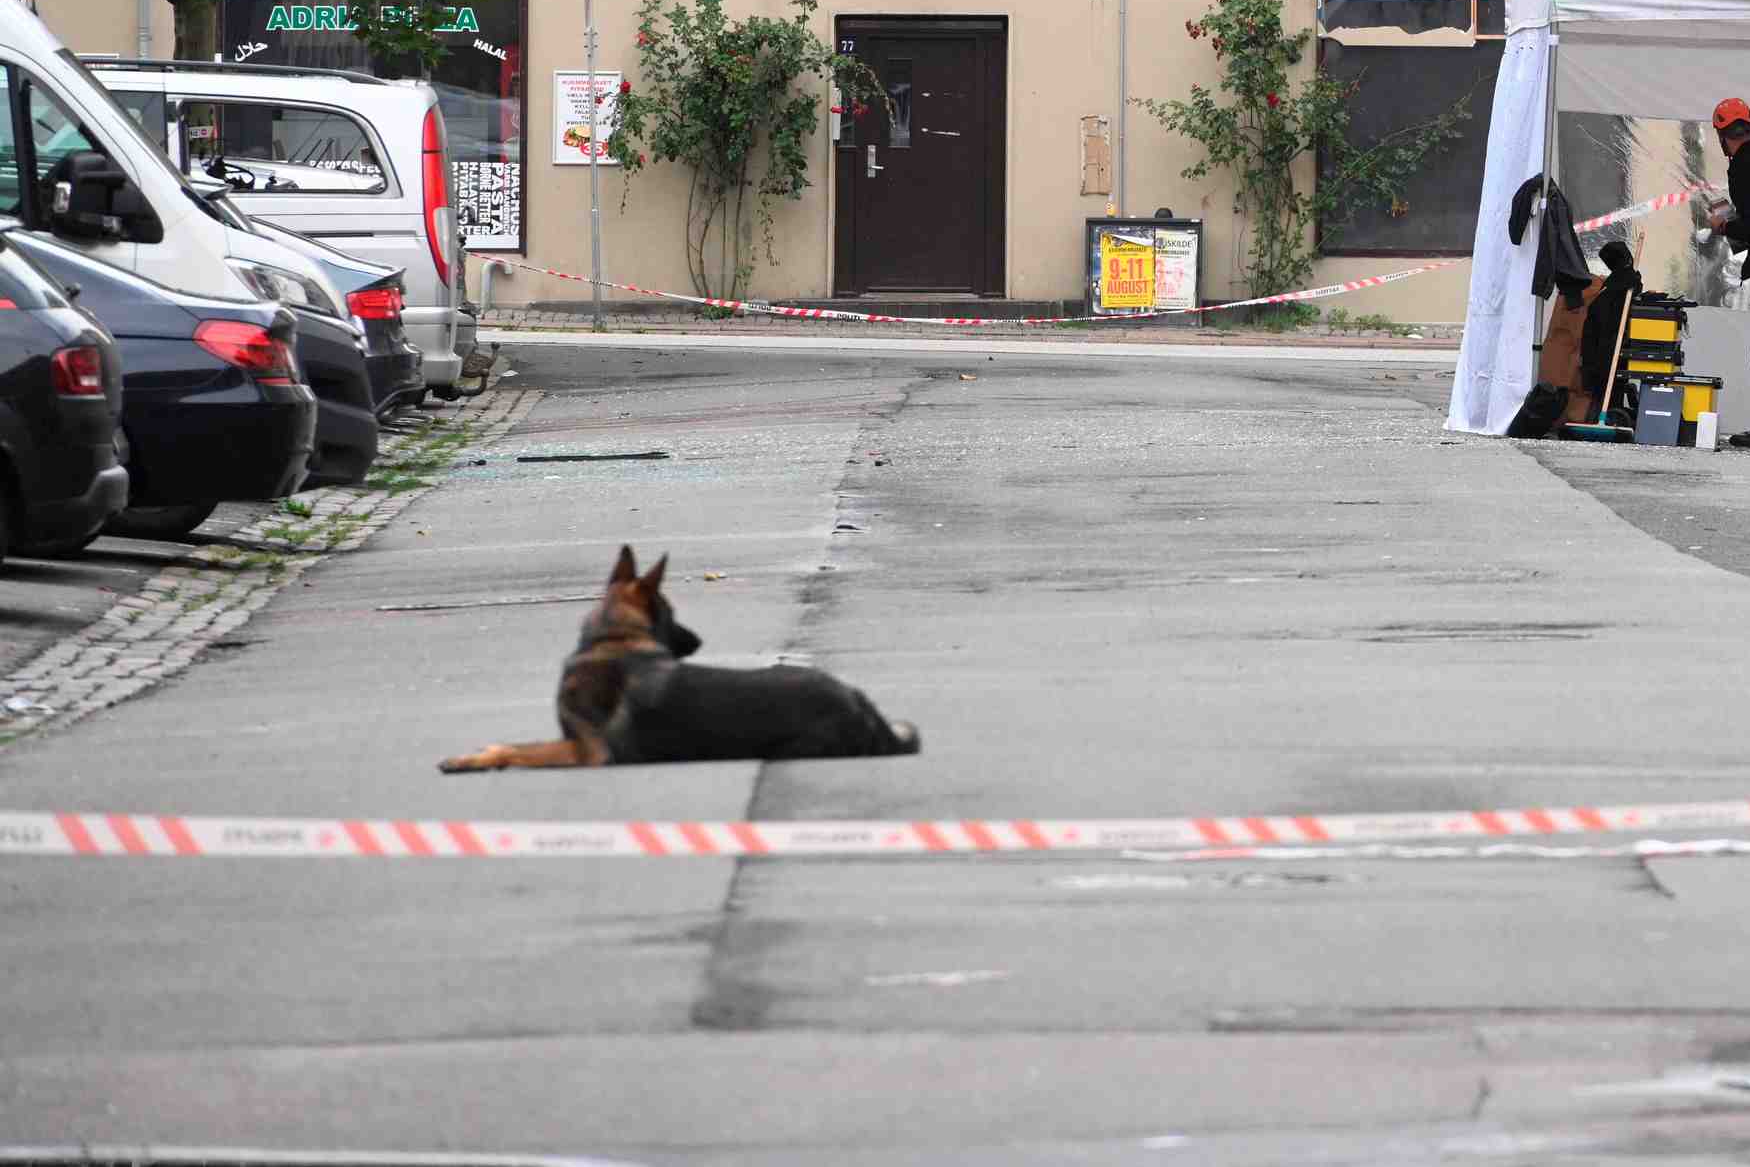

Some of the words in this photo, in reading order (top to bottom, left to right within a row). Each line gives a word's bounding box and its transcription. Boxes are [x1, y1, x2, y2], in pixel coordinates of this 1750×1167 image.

[472, 38, 508, 61] HALAL
[491, 162, 505, 234] PASTA
[1109, 258, 1144, 280] 9-11
[1107, 280, 1149, 295] AUGUST
